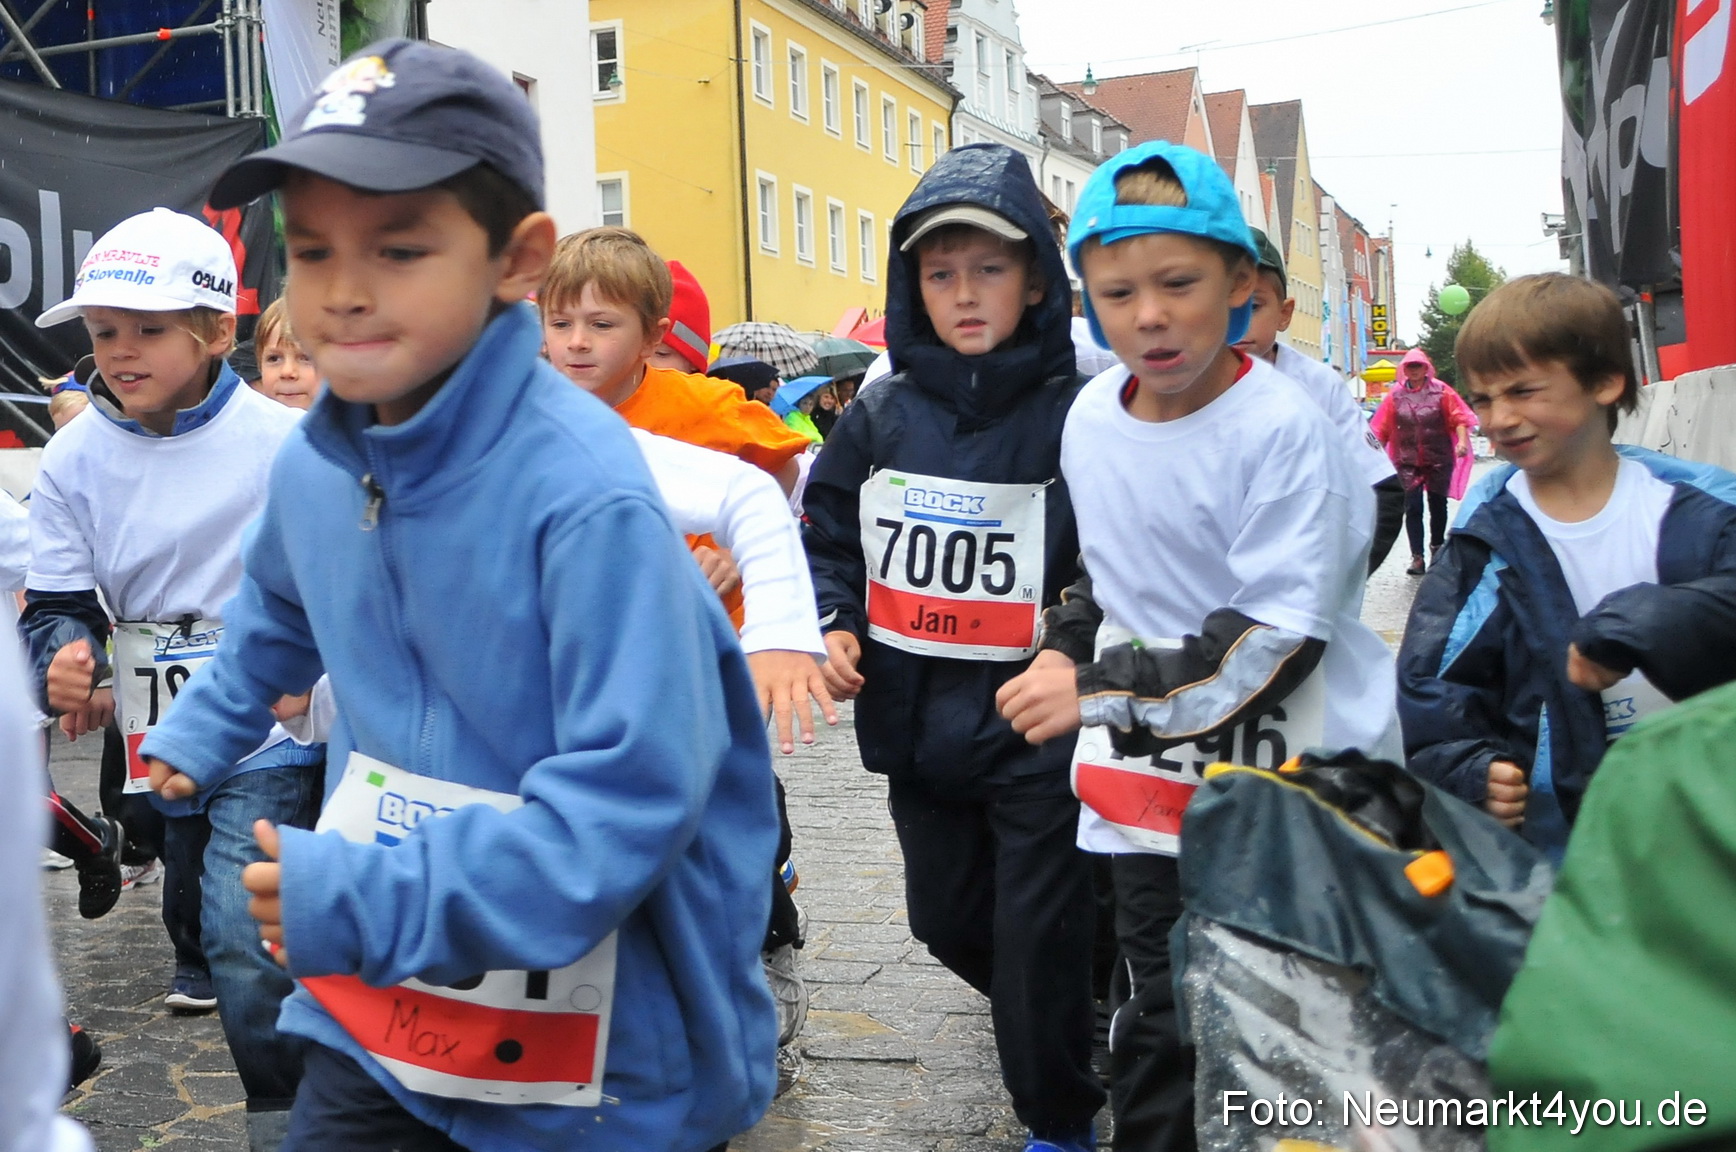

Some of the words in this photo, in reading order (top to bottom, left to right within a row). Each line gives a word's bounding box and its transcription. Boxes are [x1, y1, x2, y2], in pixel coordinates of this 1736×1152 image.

[192, 270, 233, 297] OBLAK
[904, 488, 985, 514] BOCK
[876, 517, 1016, 596] 7005
[910, 604, 958, 635] Jan
[385, 998, 460, 1062] Max
